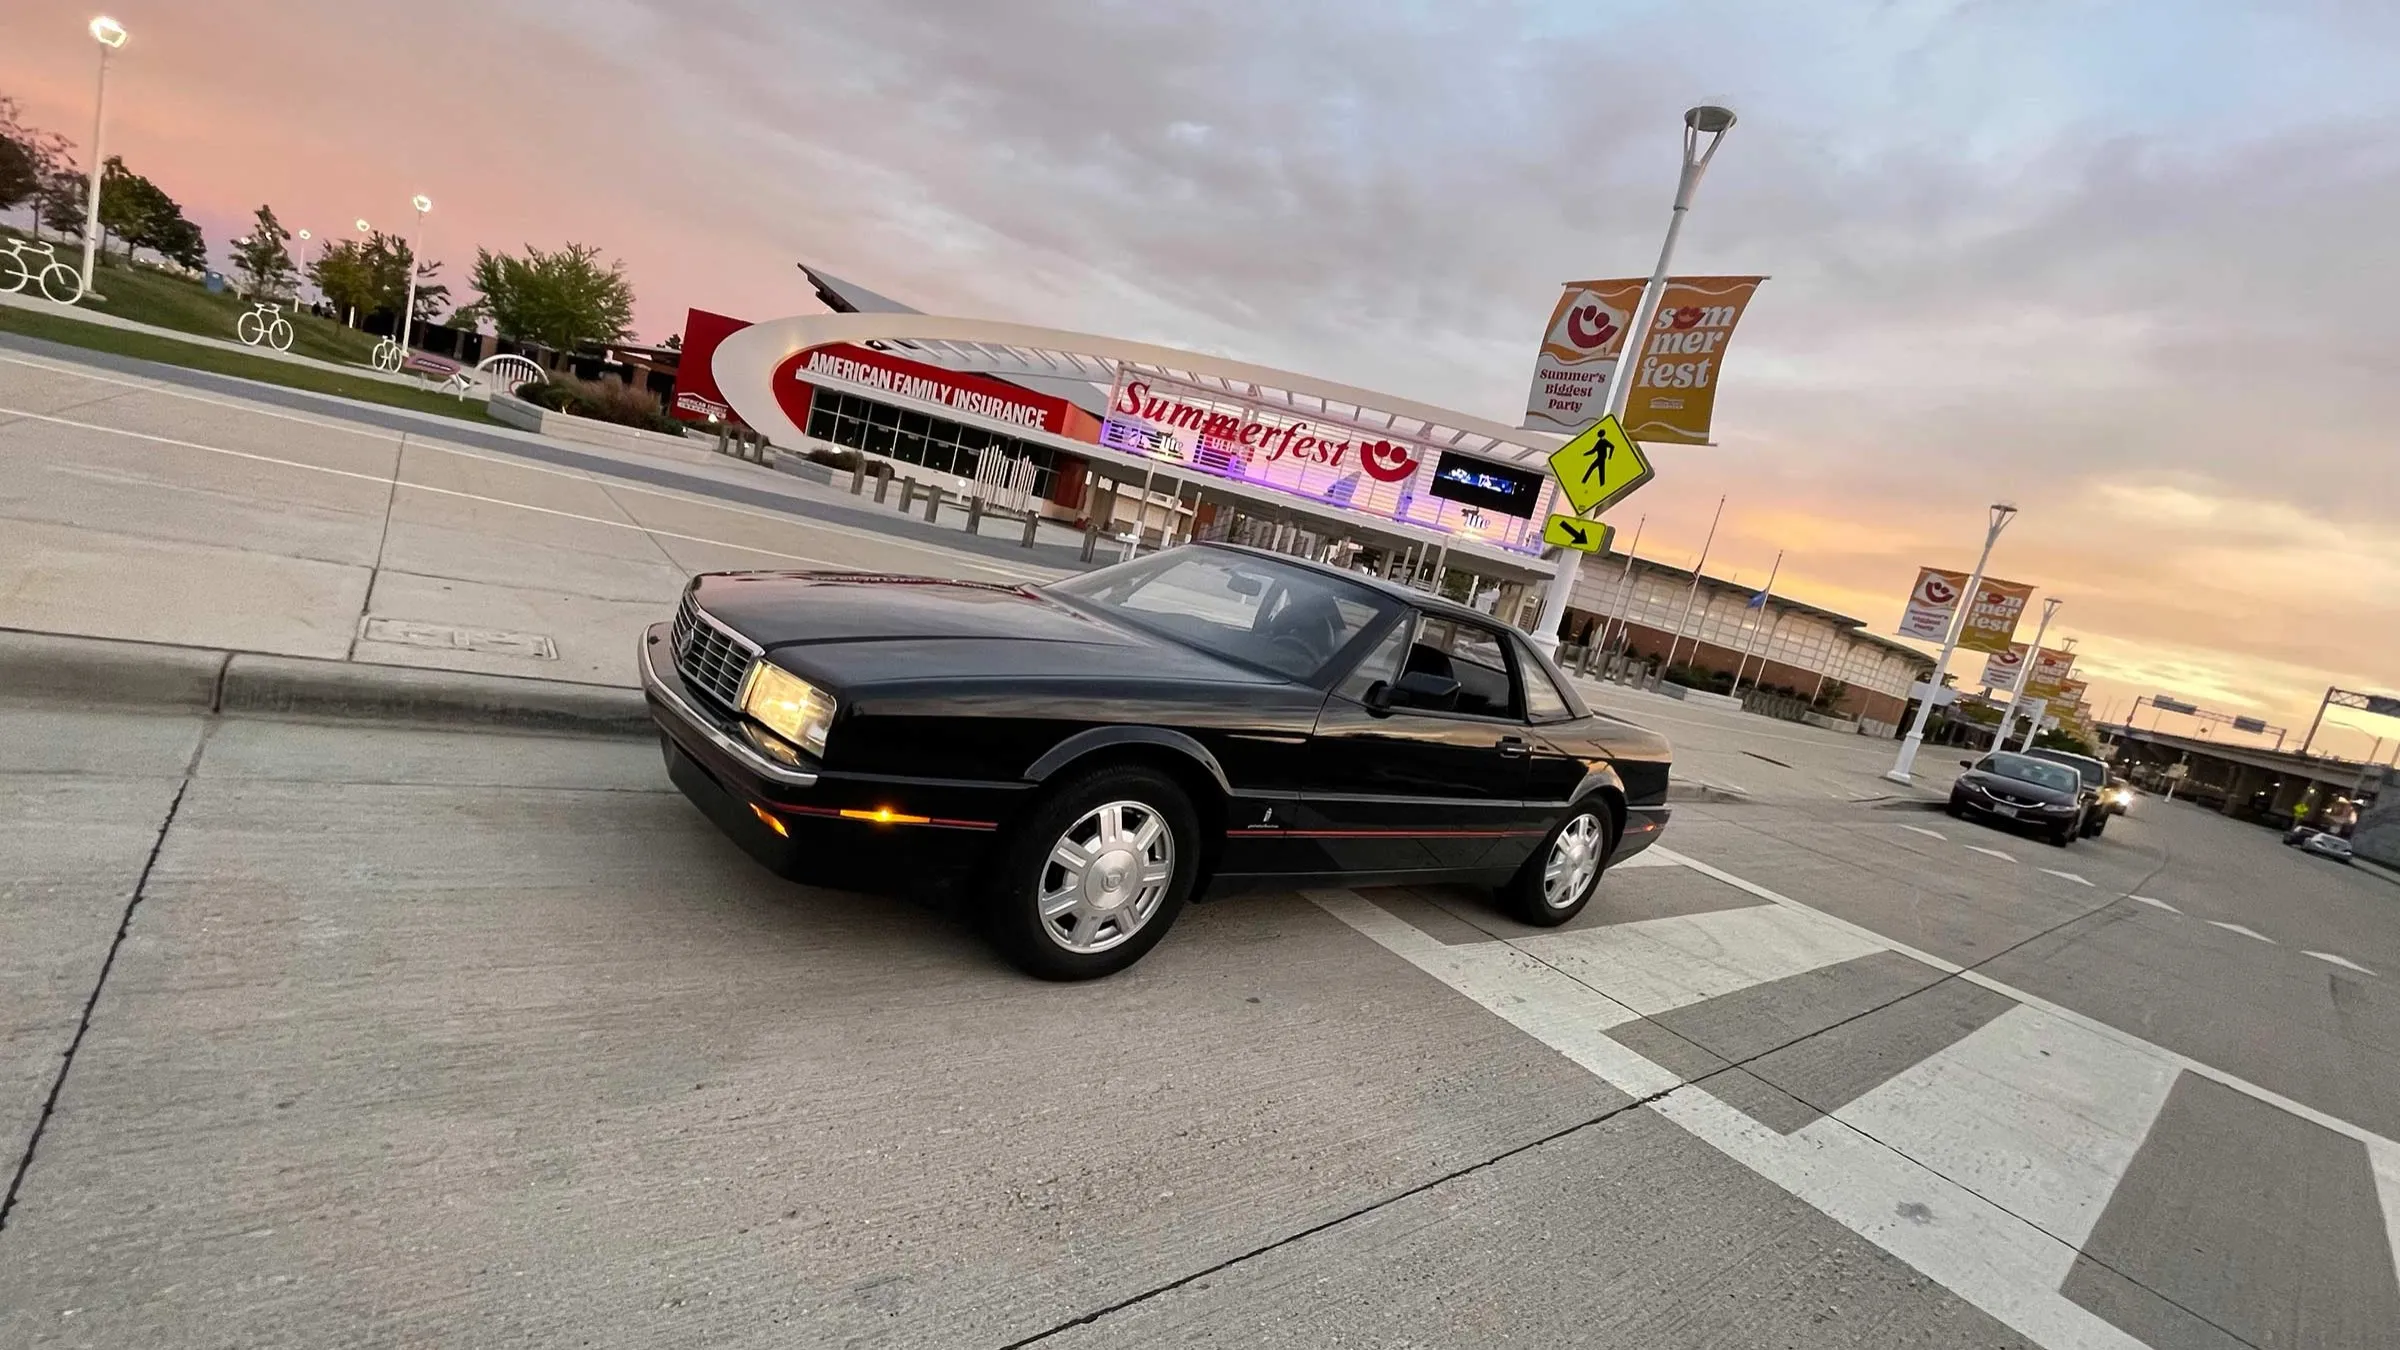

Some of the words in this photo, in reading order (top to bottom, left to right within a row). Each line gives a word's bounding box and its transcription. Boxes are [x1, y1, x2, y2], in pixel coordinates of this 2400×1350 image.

[1651, 331, 1725, 355] mer
[1539, 368, 1606, 383] Summer's
[1638, 355, 1712, 389] fest
[807, 351, 892, 389] AMERICAN
[893, 372, 952, 405] FAMILY
[951, 388, 1048, 430] INSURANCE
[1544, 383, 1593, 398] Biggest
[1547, 398, 1583, 413] Party
[1116, 381, 1350, 467] Summerfest
